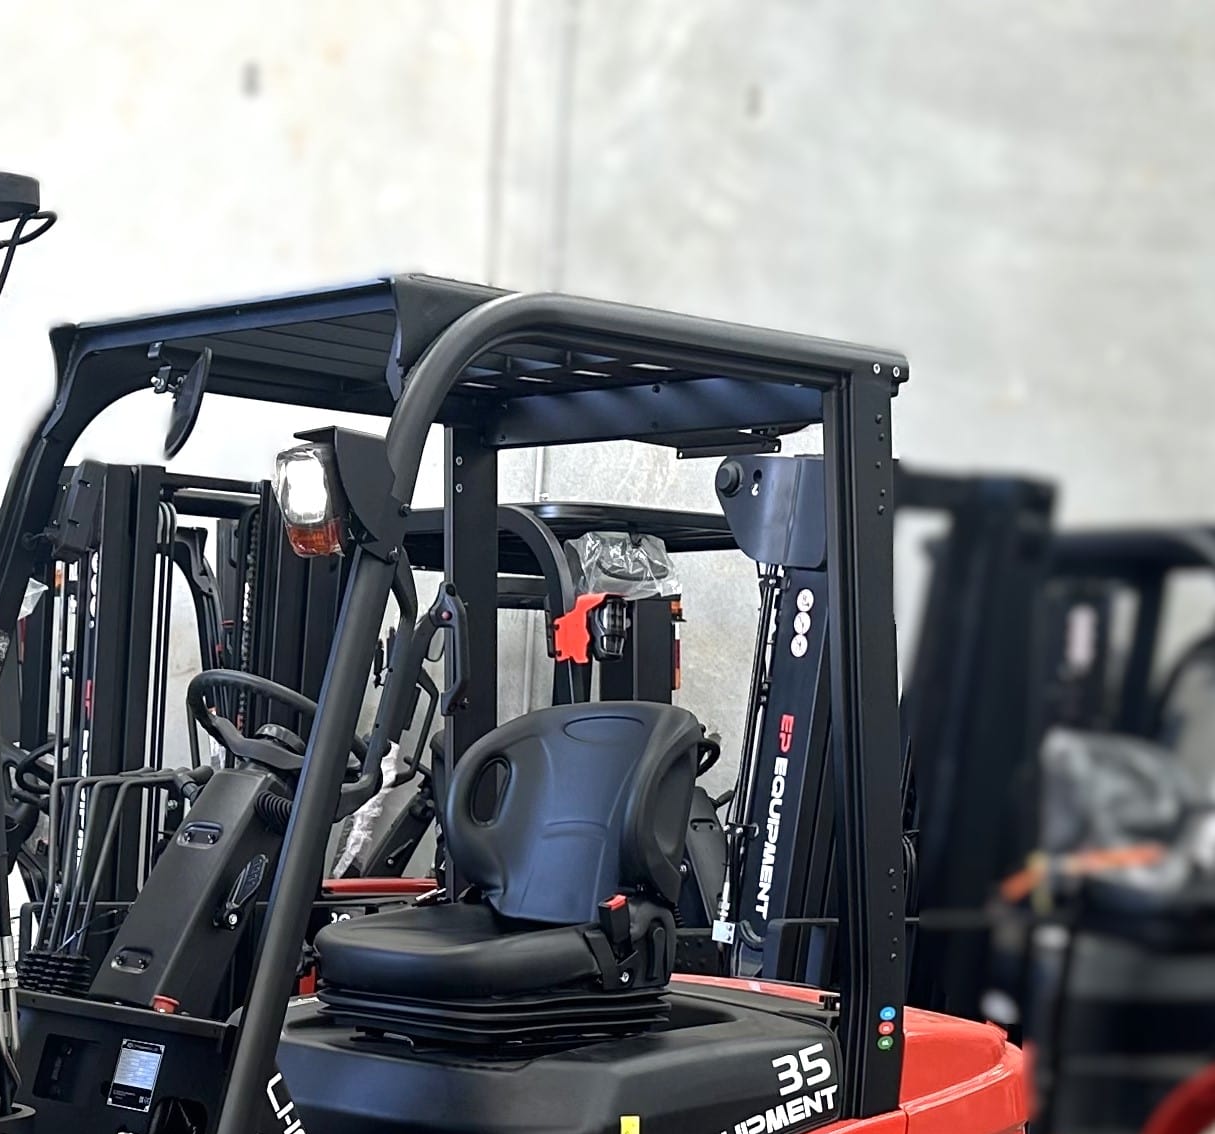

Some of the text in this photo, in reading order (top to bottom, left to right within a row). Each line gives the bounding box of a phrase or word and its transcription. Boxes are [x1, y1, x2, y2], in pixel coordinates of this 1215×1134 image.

[755, 714, 794, 921] EP EQUIPMENT
[771, 1042, 832, 1097] 35
